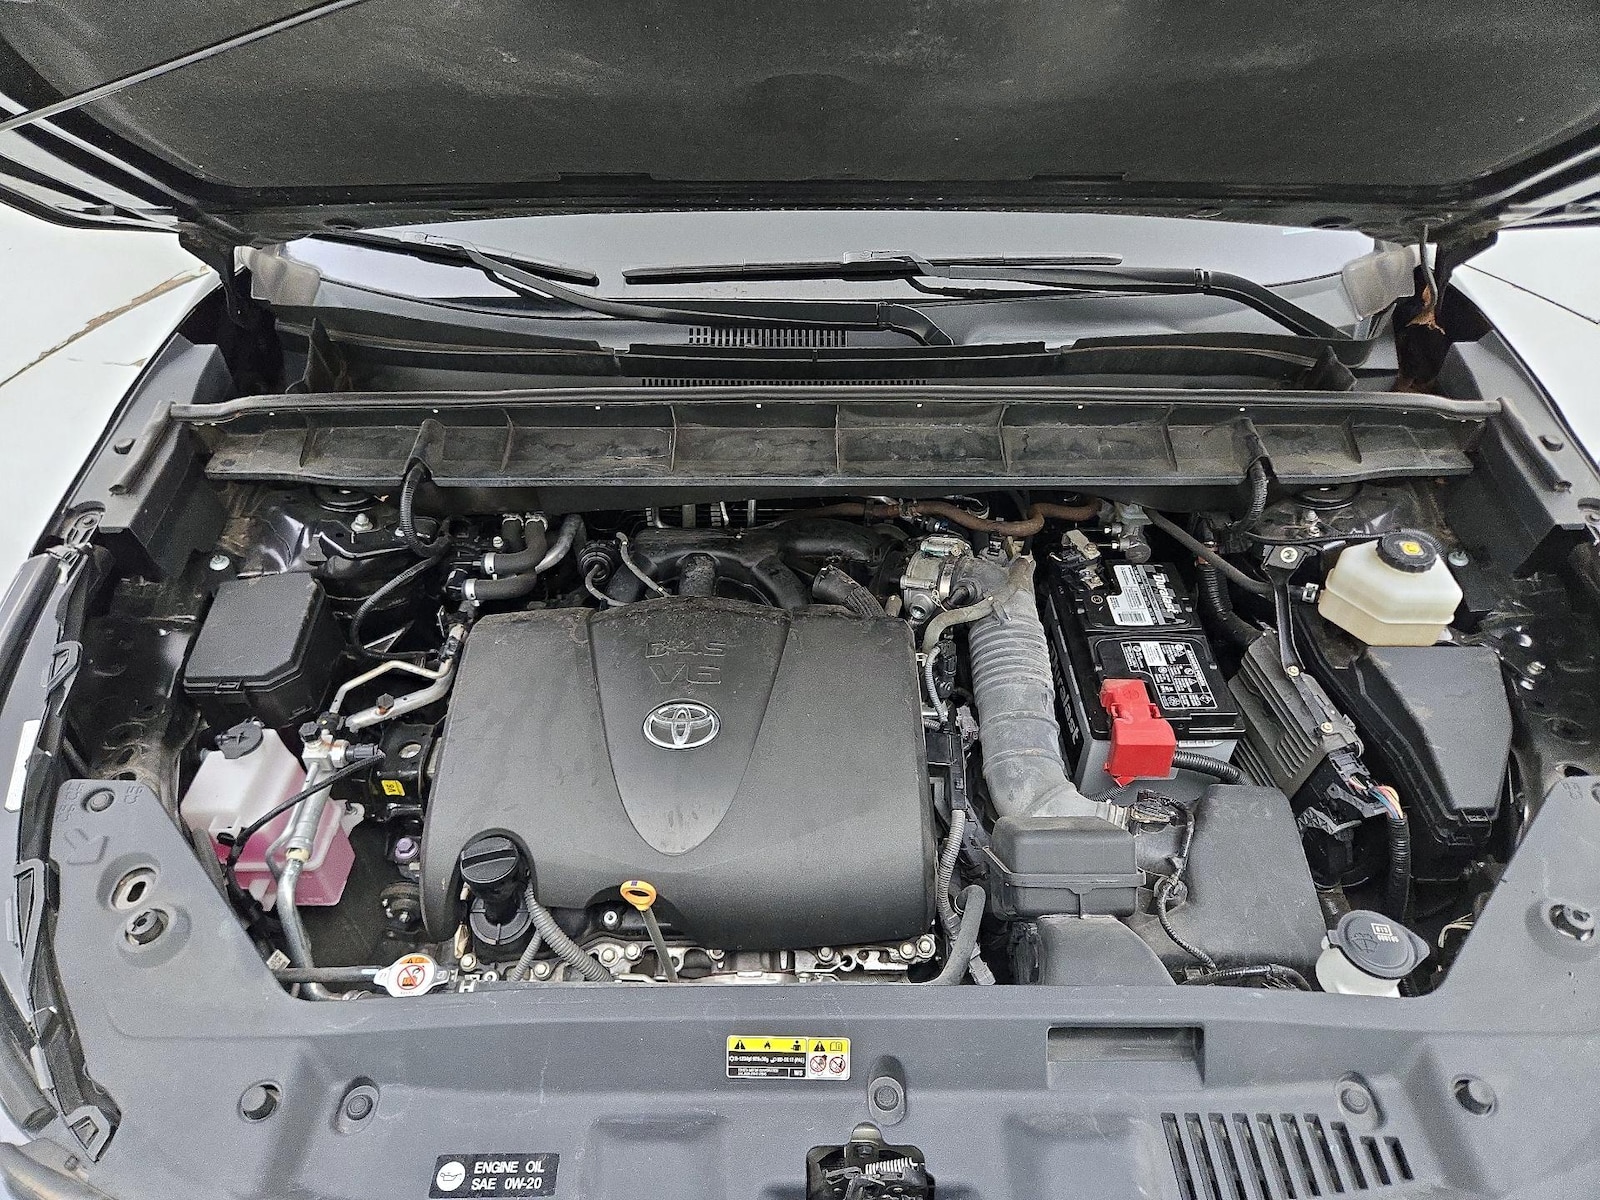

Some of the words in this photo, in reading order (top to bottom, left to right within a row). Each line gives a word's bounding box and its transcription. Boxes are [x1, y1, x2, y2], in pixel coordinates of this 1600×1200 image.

[1153, 572, 1180, 615] Duralast
[648, 661, 722, 685] V6
[473, 1161, 519, 1174] ENGINE
[525, 1160, 545, 1173] OIL
[471, 1177, 497, 1190] SAE
[504, 1177, 543, 1190] 0W-20
